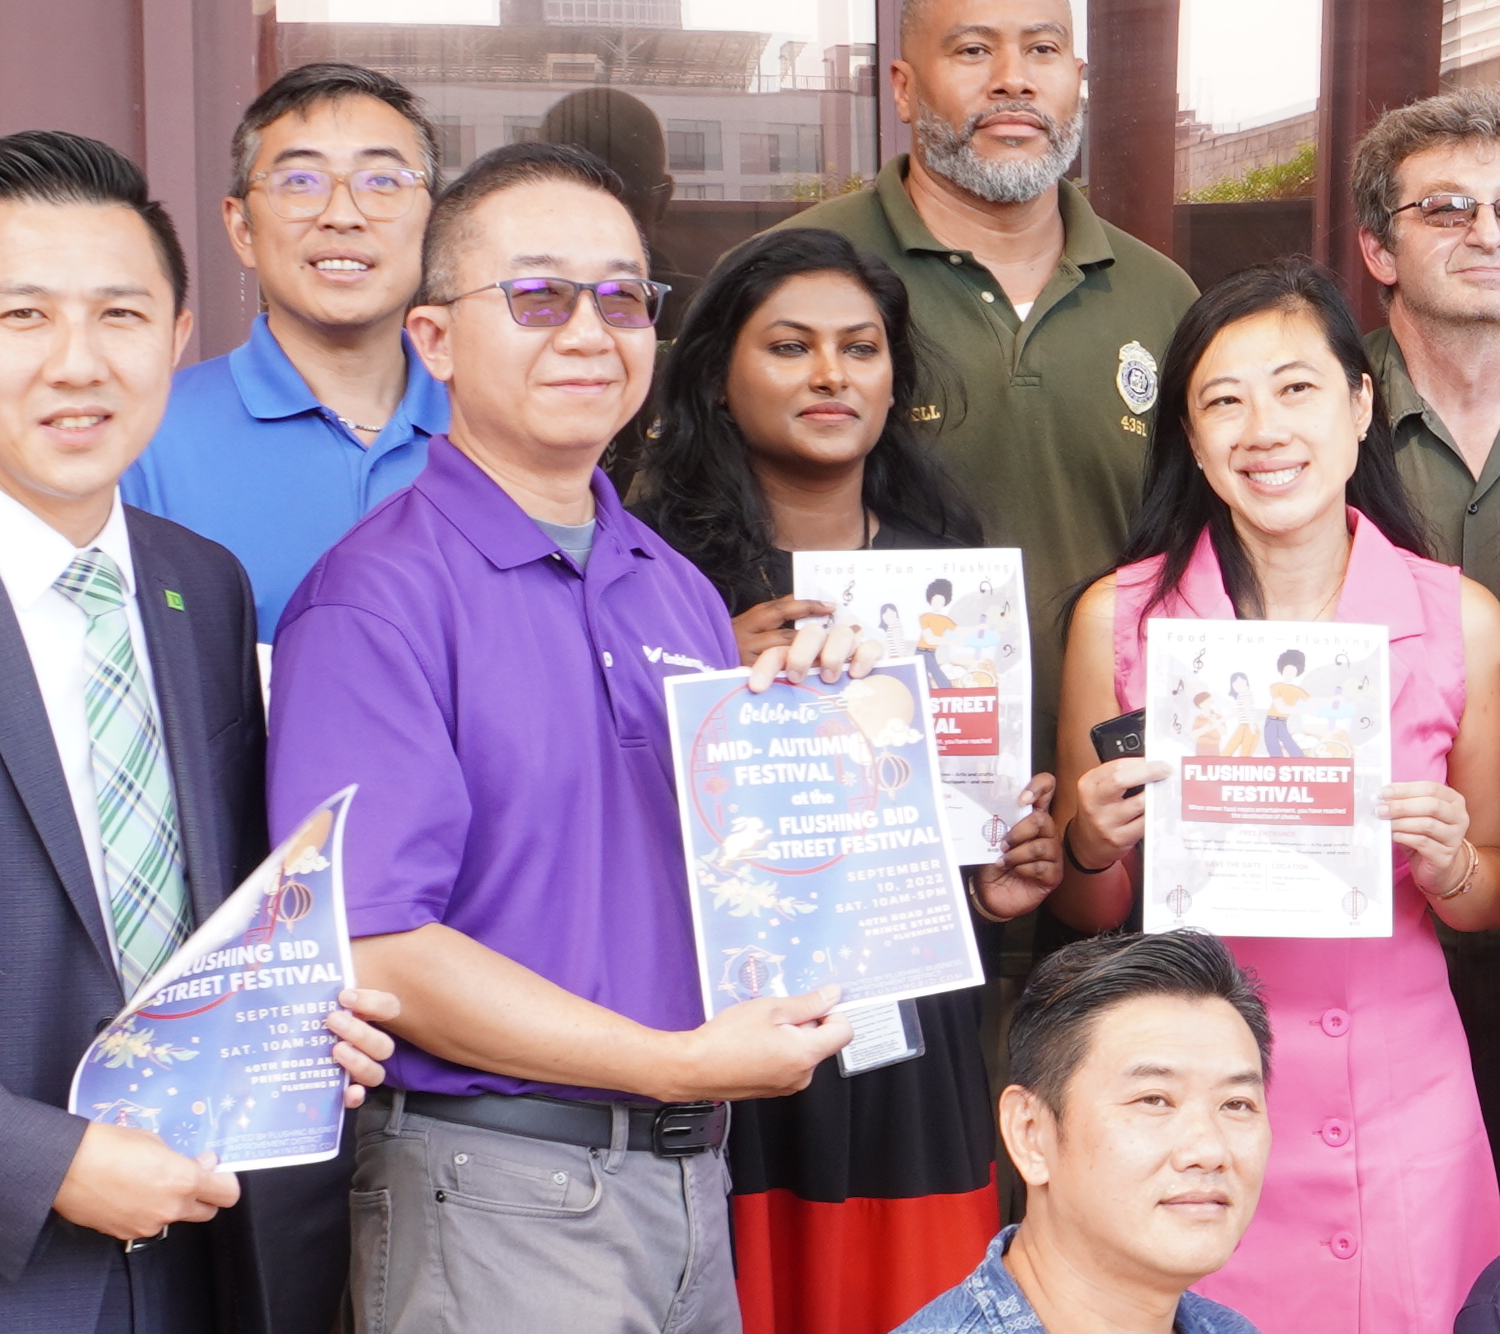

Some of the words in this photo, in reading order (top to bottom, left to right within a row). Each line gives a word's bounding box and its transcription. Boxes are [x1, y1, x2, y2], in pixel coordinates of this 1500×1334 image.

[814, 563, 855, 576] Food
[885, 563, 914, 575] Fun
[942, 561, 1009, 576] Flushing
[1167, 631, 1206, 643] Food
[1237, 633, 1264, 644] Fun
[1295, 634, 1370, 648] Flushing
[740, 702, 819, 725] Celebrate
[929, 696, 996, 714] STREET
[768, 733, 860, 758] AUTUMN
[735, 762, 834, 786] FESTIVAL
[1184, 765, 1276, 782] FLUSHING
[1279, 765, 1352, 784] STREET
[791, 792, 809, 805] at
[810, 788, 834, 805] the
[1221, 785, 1315, 804] FESTIVAL
[779, 810, 879, 836] FLUSHING
[882, 806, 920, 827] BID
[767, 838, 837, 861] STREET
[841, 825, 941, 856] FESTIVAL
[846, 859, 941, 883] SEPTEMBER
[905, 873, 945, 888] 2022
[871, 886, 948, 908] 10AM-5PM
[926, 904, 951, 916] AND
[180, 943, 275, 977] LUSHING
[279, 940, 320, 962] BID
[153, 975, 226, 1007] STREET
[230, 962, 342, 992] FESTIVAL
[236, 1000, 338, 1023] SEPTEMBER
[301, 1017, 329, 1032] 202
